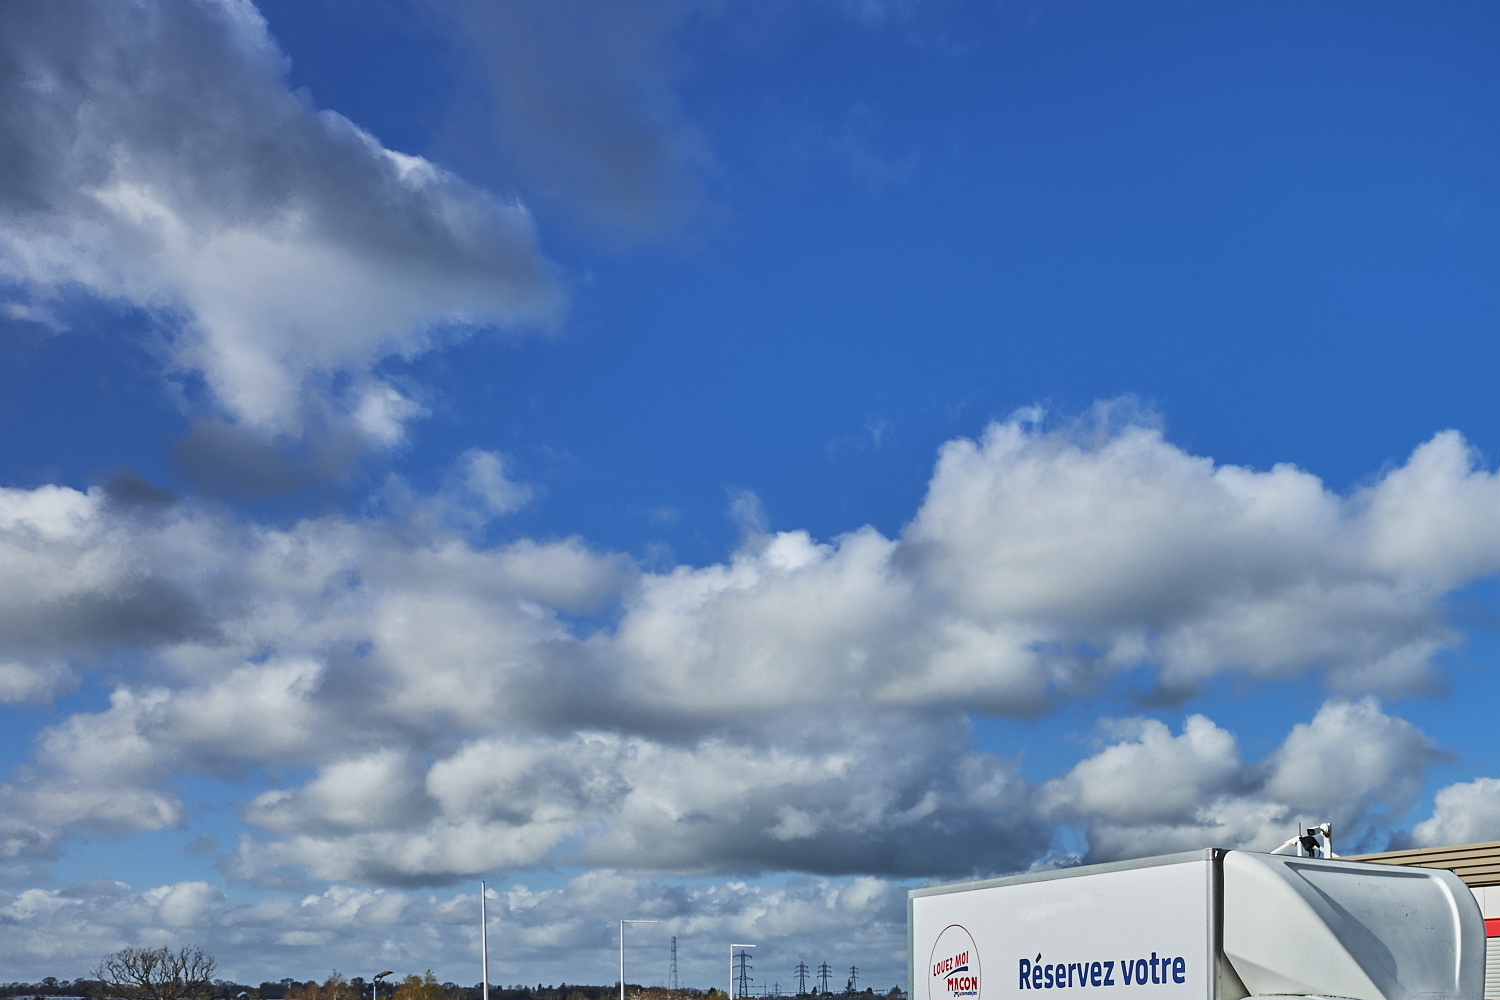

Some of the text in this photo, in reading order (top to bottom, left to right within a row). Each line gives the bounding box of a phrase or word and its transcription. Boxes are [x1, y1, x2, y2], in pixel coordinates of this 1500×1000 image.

[933, 950, 969, 976] LOUEZ MOI
[1019, 952, 1186, 990] Réservez votre
[947, 976, 978, 992] MACON
